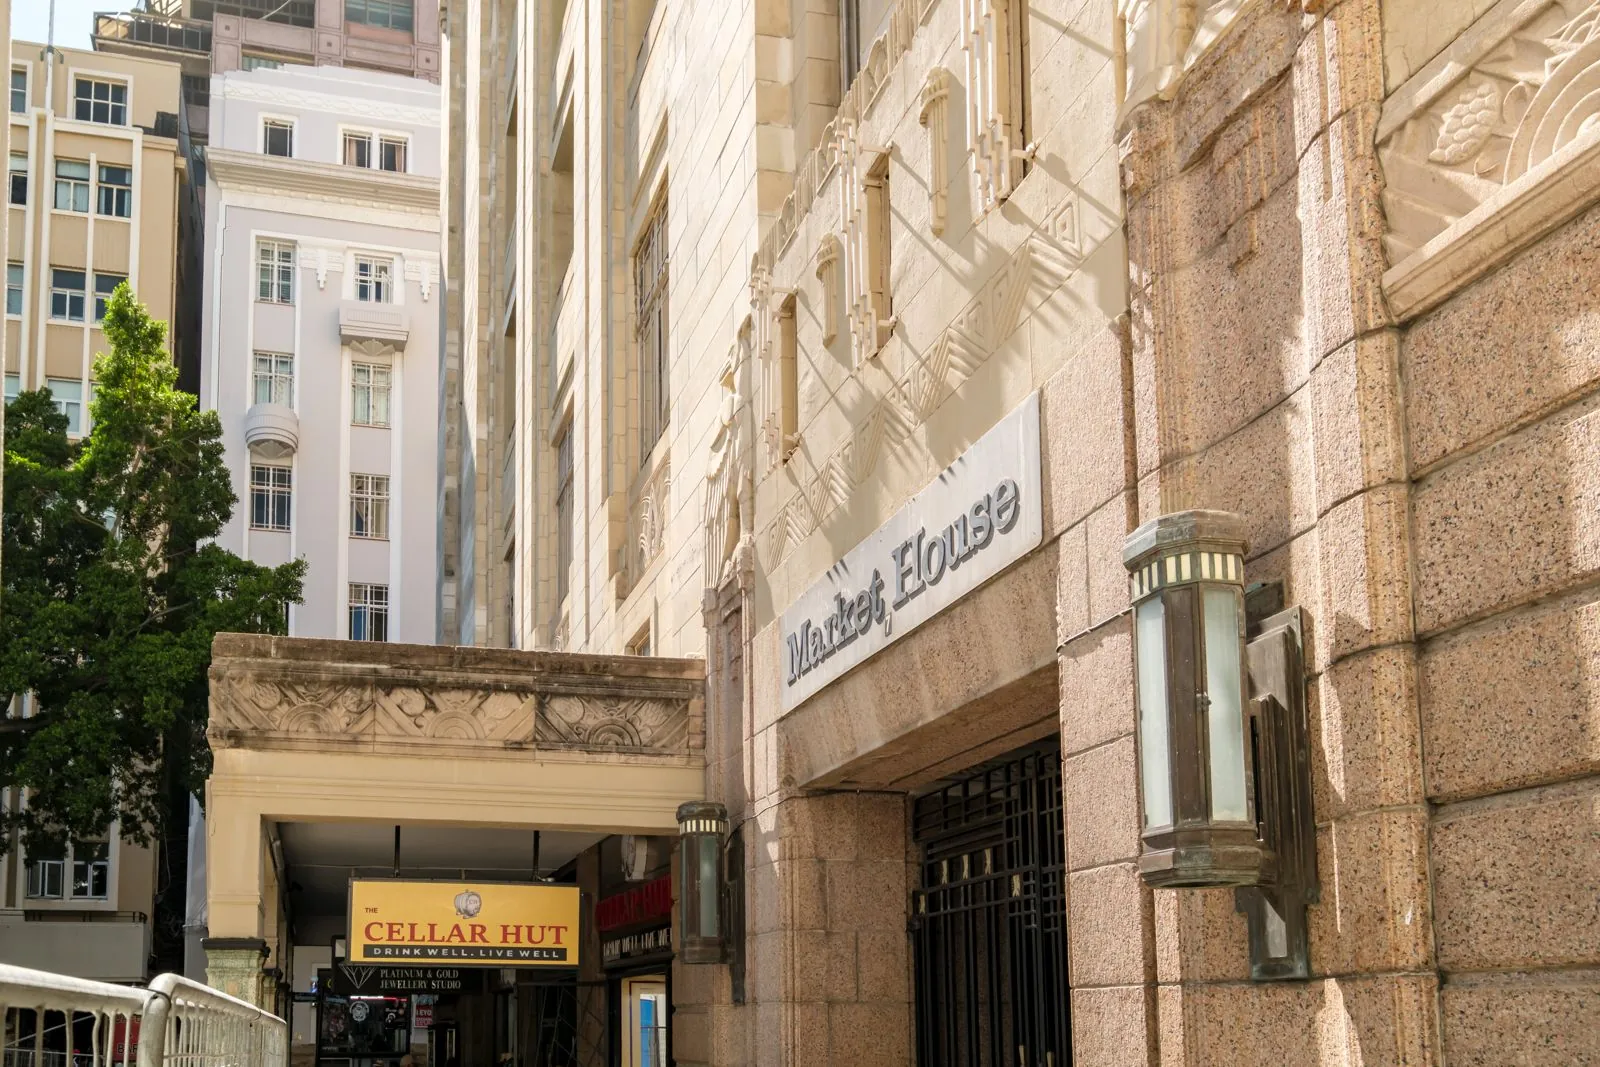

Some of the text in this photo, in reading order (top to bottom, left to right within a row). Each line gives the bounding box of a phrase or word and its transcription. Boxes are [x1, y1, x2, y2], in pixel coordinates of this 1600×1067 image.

[786, 477, 1020, 687] Market House
[364, 922, 568, 945] CELLAR HUT
[373, 947, 559, 958] DRINK WELL. LIVE WELL
[380, 968, 459, 979] PLATINUM & GOLD
[380, 979, 461, 989] JEWELLERY STUDIO
